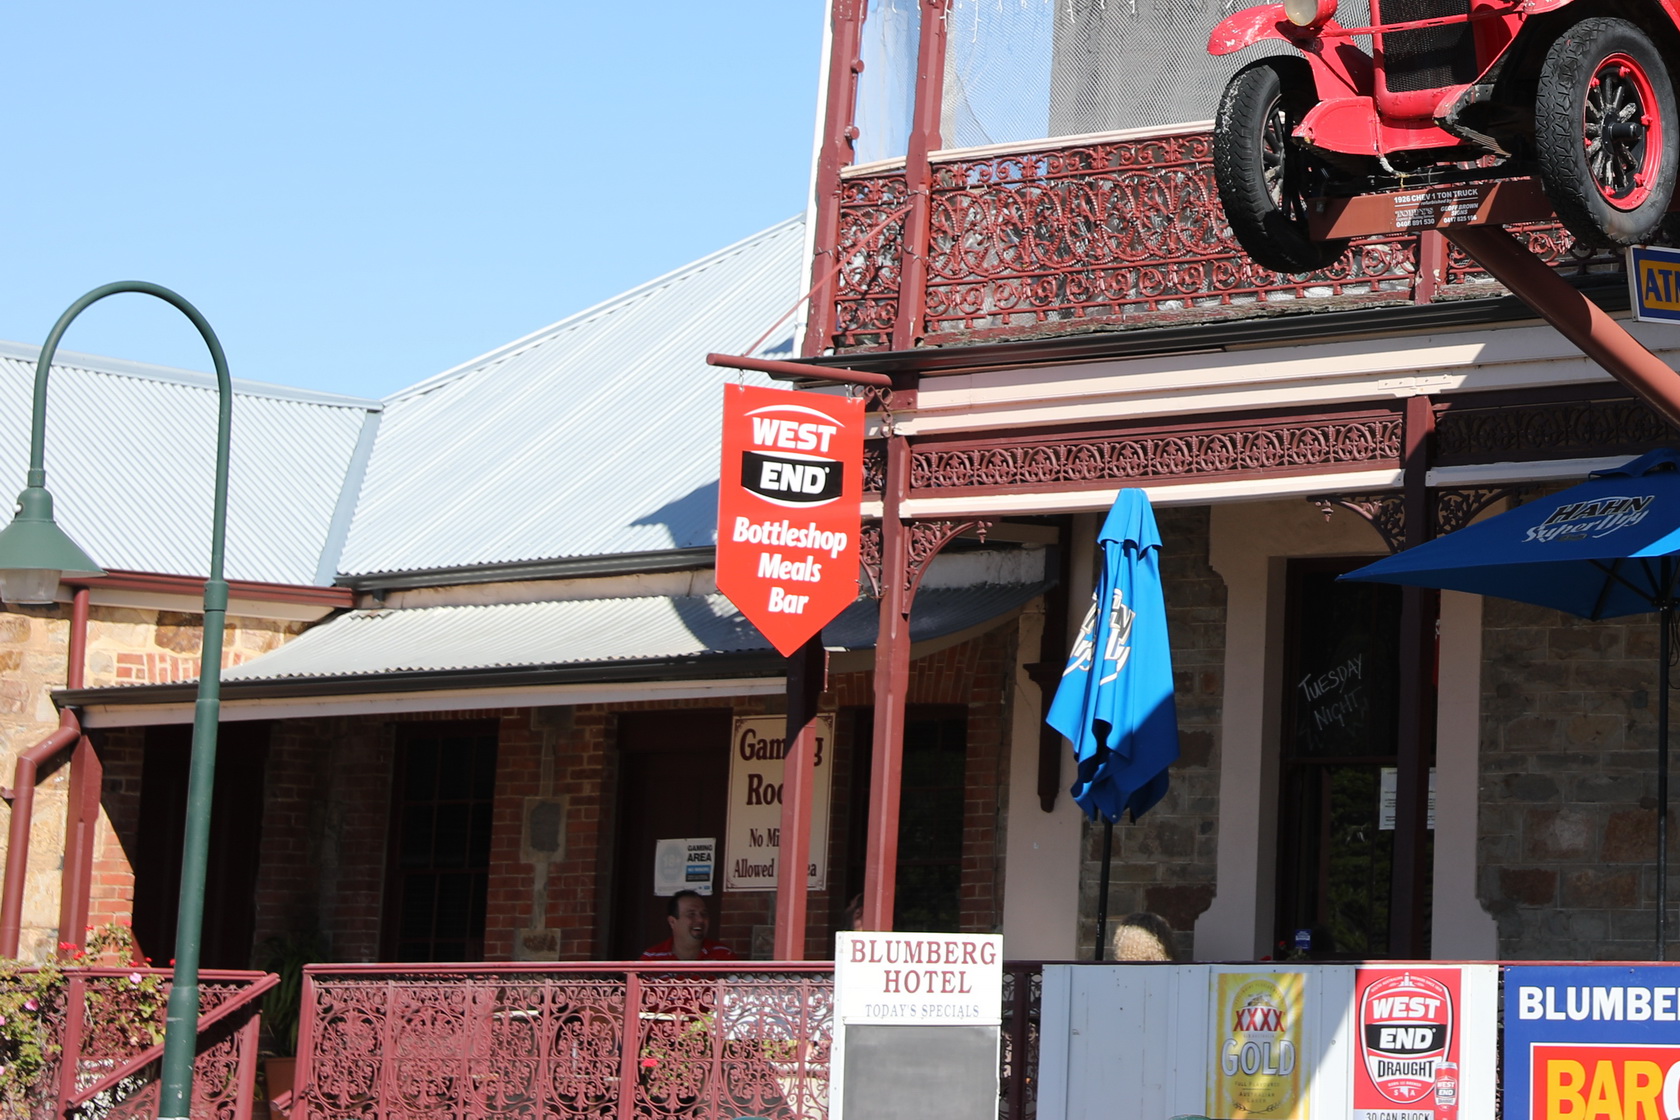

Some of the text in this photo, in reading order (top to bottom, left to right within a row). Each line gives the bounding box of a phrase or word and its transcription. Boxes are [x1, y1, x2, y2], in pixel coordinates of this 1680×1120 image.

[1394, 196, 1411, 204] 1926
[1411, 193, 1431, 202] CHEV
[1437, 191, 1452, 199] TON
[1453, 189, 1478, 198] TRUCK
[752, 416, 837, 452] WEST
[760, 461, 826, 494] END
[1544, 495, 1656, 526] HAHN
[733, 516, 847, 559] Bottleshop
[757, 552, 822, 582] Meals
[768, 587, 809, 614] Bar
[1298, 653, 1362, 702] TUESDAY
[1314, 686, 1362, 731] NIGHT
[740, 728, 824, 767] Gamg
[749, 828, 763, 847] No
[687, 853, 712, 862] AREA
[733, 858, 774, 878] Allowed
[850, 939, 996, 965] BLUMBERG
[883, 970, 972, 994] HOTEL
[865, 1004, 979, 1017] TODAY'S SPECIALS
[1233, 1007, 1286, 1032] XXXX
[1372, 996, 1440, 1019] WEST
[1379, 1027, 1433, 1049] END
[1221, 1038, 1296, 1077] GOLD
[1377, 1060, 1434, 1079] DRAUGHT
